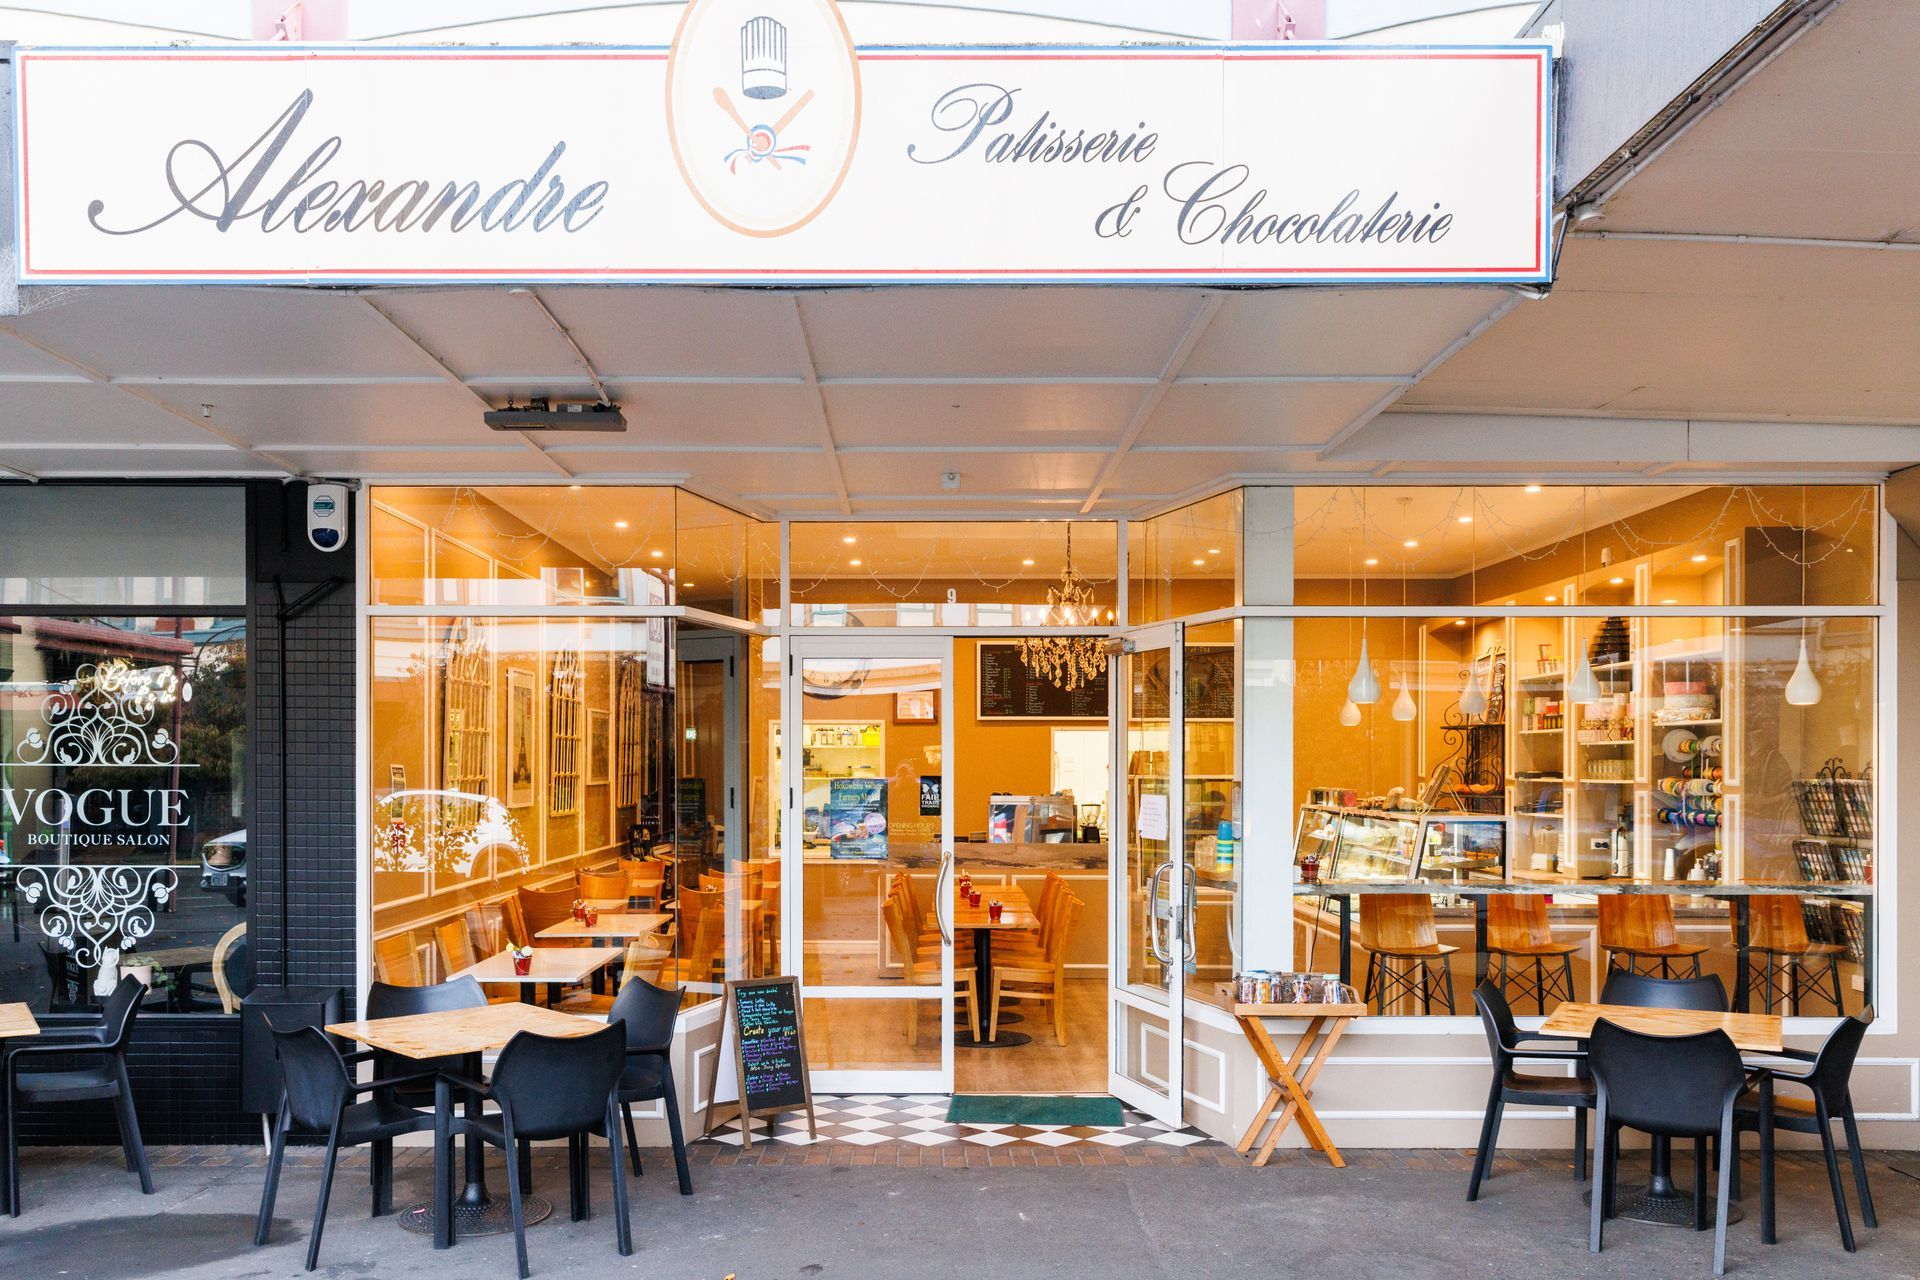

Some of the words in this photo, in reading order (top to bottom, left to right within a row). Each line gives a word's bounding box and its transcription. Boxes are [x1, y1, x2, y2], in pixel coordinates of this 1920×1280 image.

[907, 83, 1159, 165] Patisserie
[88, 88, 609, 235] Alexandre
[1094, 184, 1148, 238] &
[1163, 161, 1454, 245] Chocolaterie
[947, 588, 957, 605] 9
[1, 788, 191, 827] VOGUE
[28, 834, 113, 847] BOUTIQUE
[117, 834, 170, 846] SALON
[744, 1025, 765, 1036] Create
[768, 1027, 781, 1037] your
